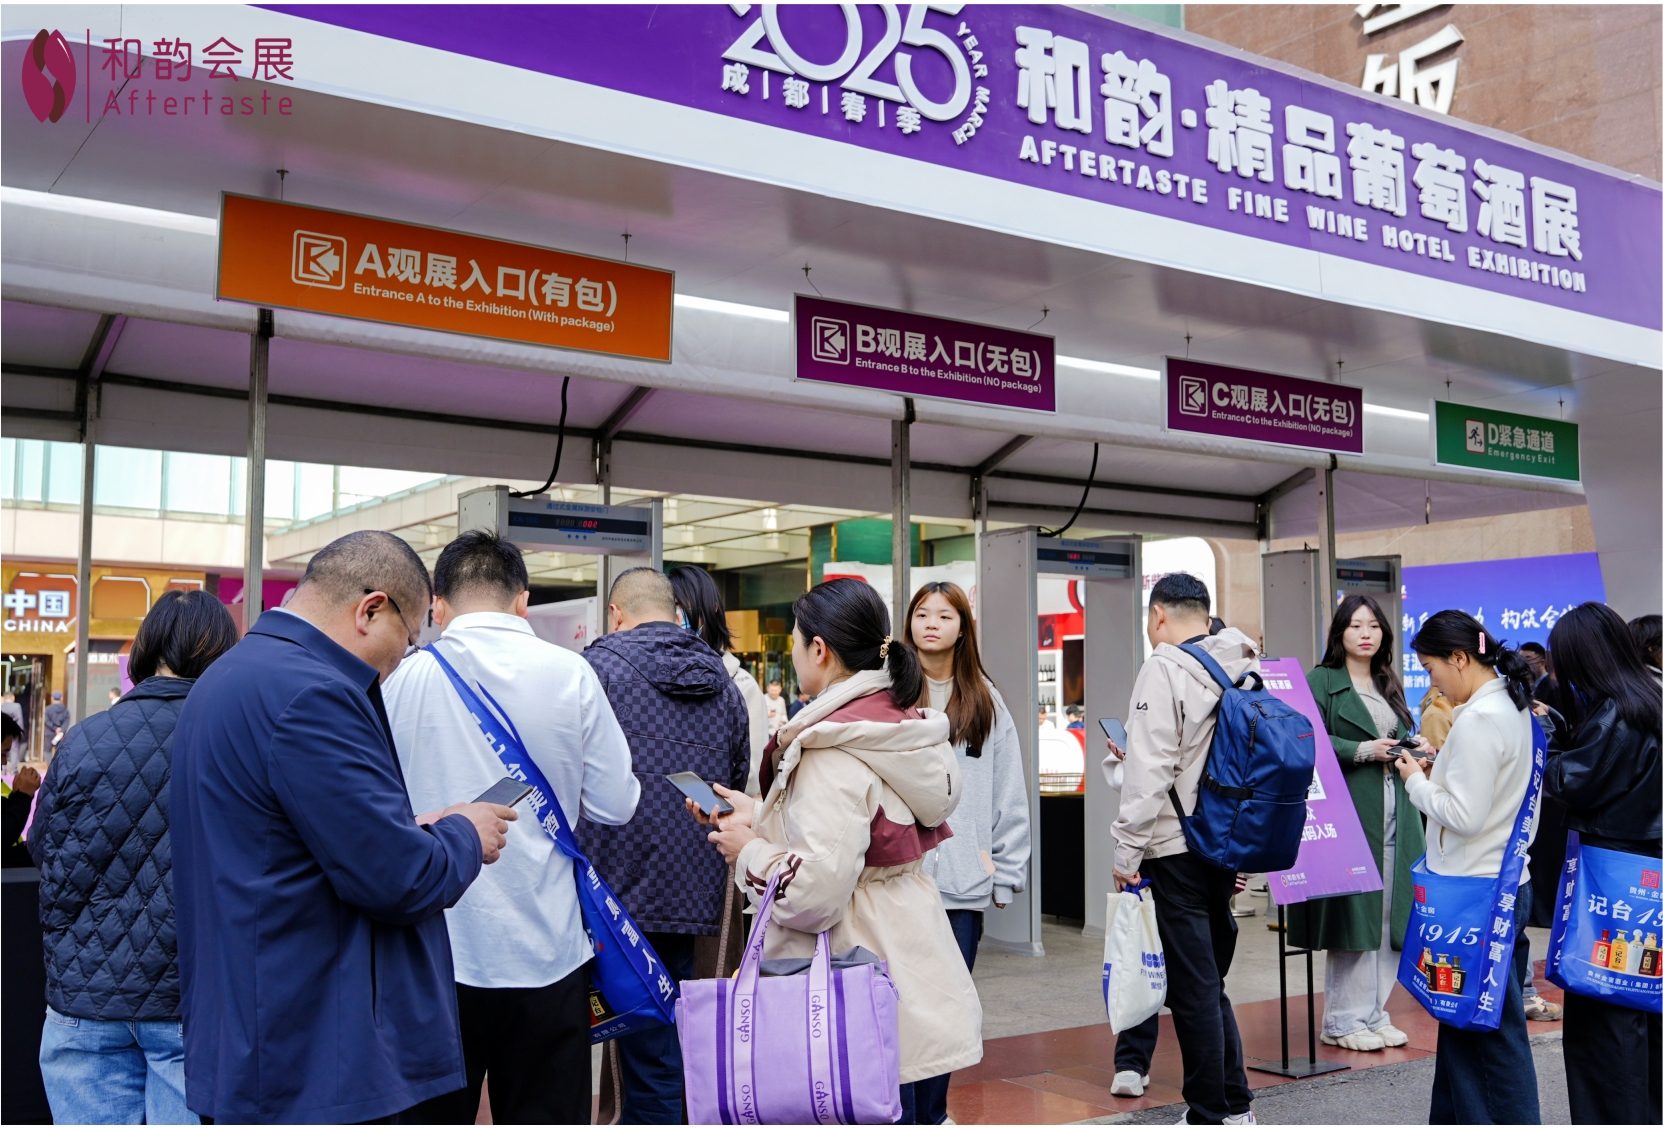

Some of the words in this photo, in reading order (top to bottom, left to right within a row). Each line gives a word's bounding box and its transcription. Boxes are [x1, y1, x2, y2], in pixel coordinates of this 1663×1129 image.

[957, 22, 988, 78] YEAR
[952, 86, 990, 145] MARCH
[1015, 26, 1583, 261] 和韵·精品葡萄酒展
[1020, 136, 1208, 204] AFTERTASTE
[1228, 187, 1289, 223] FINE
[1306, 205, 1368, 241] WINE
[1382, 226, 1455, 262] HOTEL
[1468, 246, 1586, 293] EXHIBITION
[354, 243, 617, 317] A观展入口(有包)
[353, 283, 413, 302] Entrance
[416, 294, 425, 304] A
[428, 295, 440, 306] to
[443, 297, 464, 310] the
[466, 300, 527, 319] Exhibition
[528, 308, 558, 324] (With
[561, 316, 615, 332] package)
[855, 357, 900, 373] Entrance
[901, 364, 908, 373] B
[909, 365, 919, 375] to
[920, 367, 935, 378] the
[937, 369, 983, 385] Exhibition
[983, 375, 1000, 387] (NO
[1001, 379, 1042, 393] package)
[856, 324, 1041, 381] B观展入口(无包)
[1212, 382, 1355, 427] C观展入口(无包)
[1212, 410, 1245, 422] Entrance
[1245, 414, 1252, 424] C
[1252, 415, 1260, 425] to
[1260, 416, 1272, 426] the
[1273, 418, 1308, 431] Exhibition
[1308, 422, 1321, 433] (NO
[1321, 425, 1353, 438] package)
[1487, 423, 1555, 453] D紧急通道
[1488, 447, 1536, 463] Emergency
[1538, 454, 1555, 464] Exit
[4, 589, 70, 618] 中国
[4, 619, 69, 633] CHINA
[1588, 894, 1633, 922] 记台
[1478, 892, 1517, 1012] 享财富人生
[736, 998, 751, 1043] GANSO
[811, 994, 826, 1039] GANSO
[740, 1084, 756, 1125] GANSO
[815, 1081, 830, 1120] GANSO
